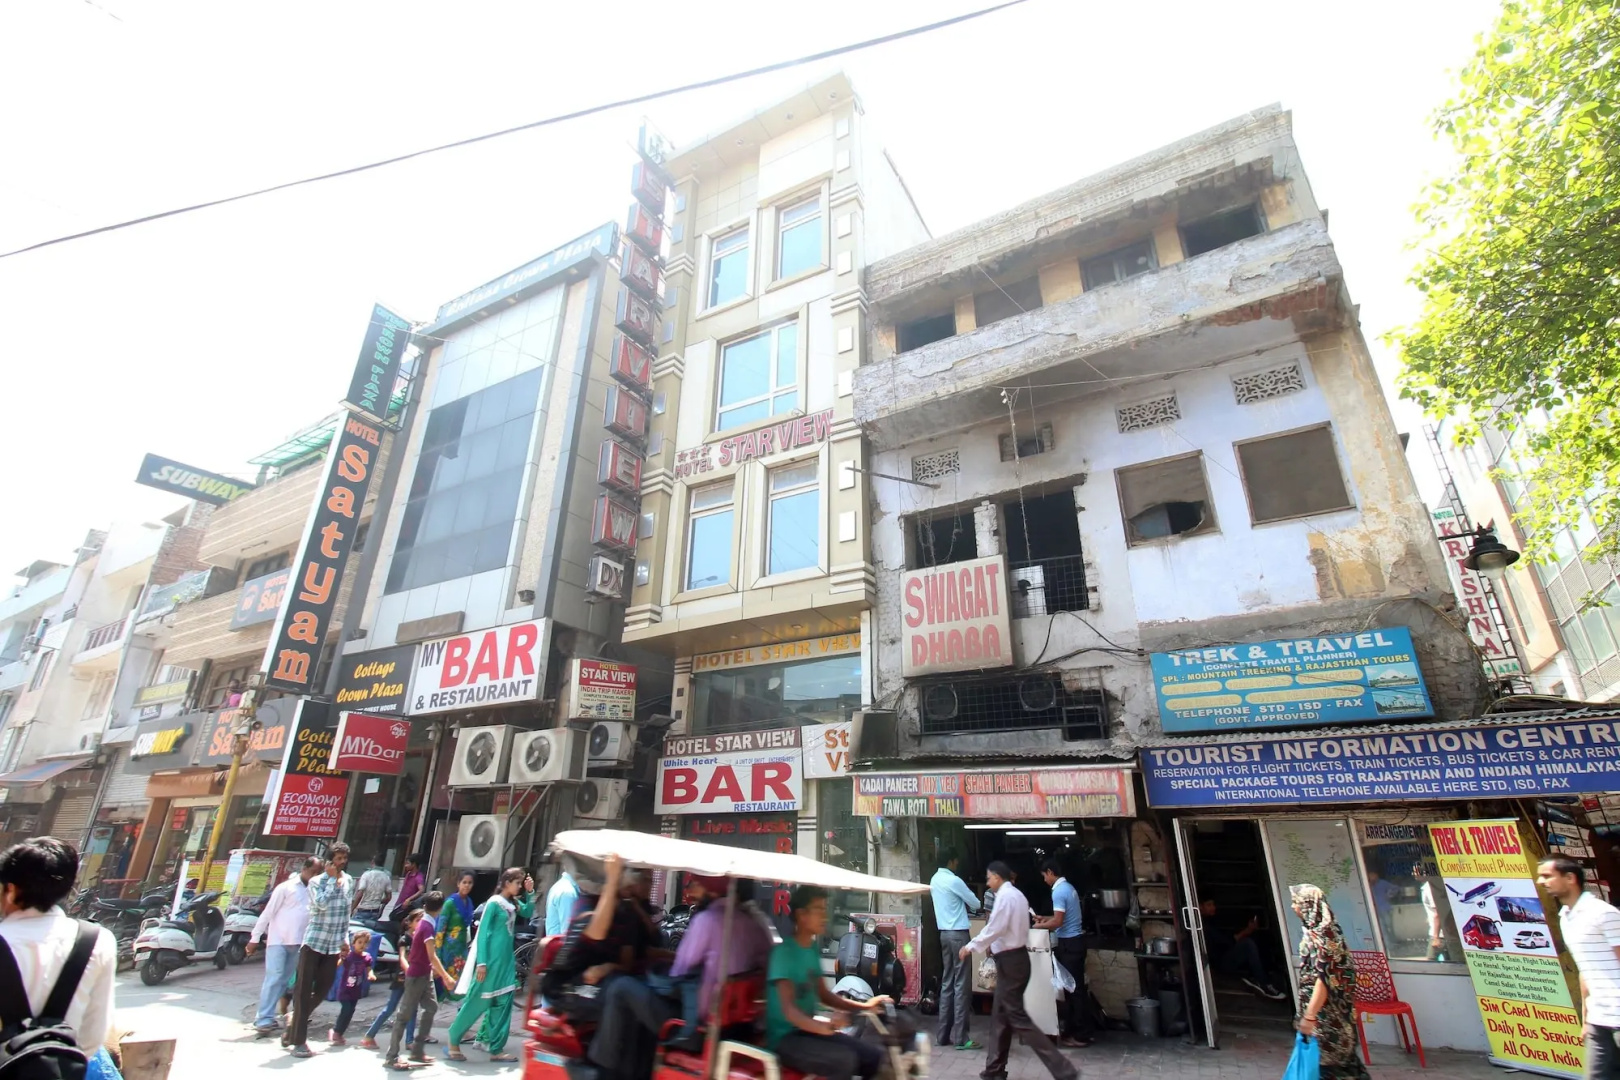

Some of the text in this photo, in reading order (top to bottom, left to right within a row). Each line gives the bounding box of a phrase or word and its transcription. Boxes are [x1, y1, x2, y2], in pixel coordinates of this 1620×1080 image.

[346, 418, 380, 446] HOTEL
[674, 410, 834, 479] HOTEL STAR VIEW
[151, 466, 250, 500] SUBWAY
[273, 444, 370, 684] Satyam
[601, 562, 624, 590] DX
[904, 564, 999, 628] SWAGAT
[421, 624, 538, 688] MY BAR
[696, 642, 811, 670] HOTEL STAR
[912, 624, 1000, 667] DHABA
[1168, 632, 1393, 666] TREK & TRAVEL
[354, 661, 396, 678] Cottage
[1188, 670, 1238, 680] MOUNTAIN
[1306, 658, 1369, 670] RAJASTHAN
[1372, 654, 1410, 664] TOURS
[1261, 656, 1300, 667] TRAVEL
[1304, 652, 1356, 662] PLANNER)
[582, 668, 636, 683] STAR VIEW
[336, 682, 404, 704] Crown Plaza
[415, 679, 532, 710] & RESTAURANT
[1174, 698, 1363, 718] TELEPHONE STD ISD FAX
[1215, 712, 1320, 726] (GOVT. APPROVED)
[667, 730, 796, 756] HOTEL STAR VIEW
[1150, 744, 1264, 766] TOURIST
[1273, 731, 1486, 760] INFORMATION
[664, 756, 718, 768] White Heart
[1154, 748, 1583, 778] RESERVATION FOR FLIGHT TICKETS, TRAIN TICKETS, BUS TICKETS & CAR
[662, 762, 795, 804] BAR
[860, 777, 918, 792] KADAI PANEER
[922, 774, 958, 794] MIX VEG
[966, 773, 1031, 793] SHAHI PANEER
[1170, 761, 1620, 790] SPECIAL PACKAGE TOURS FOR RAJASTHAN AND INDIAN HIMALAYAS
[283, 792, 341, 806] ECONOMY
[1215, 778, 1570, 800] INTERNATIONAL TELEPHONE AVAILABLE HERE STD, ISD, FAX
[279, 804, 340, 818] HOLIDAYS
[734, 802, 796, 812] RESTAURANT
[883, 798, 928, 816] TAWA ROTI
[935, 798, 960, 816] THALI
[692, 818, 795, 834] Live Music
[1430, 828, 1462, 855] TREK
[1460, 827, 1472, 855] &
[1468, 825, 1522, 855] TRAVELS
